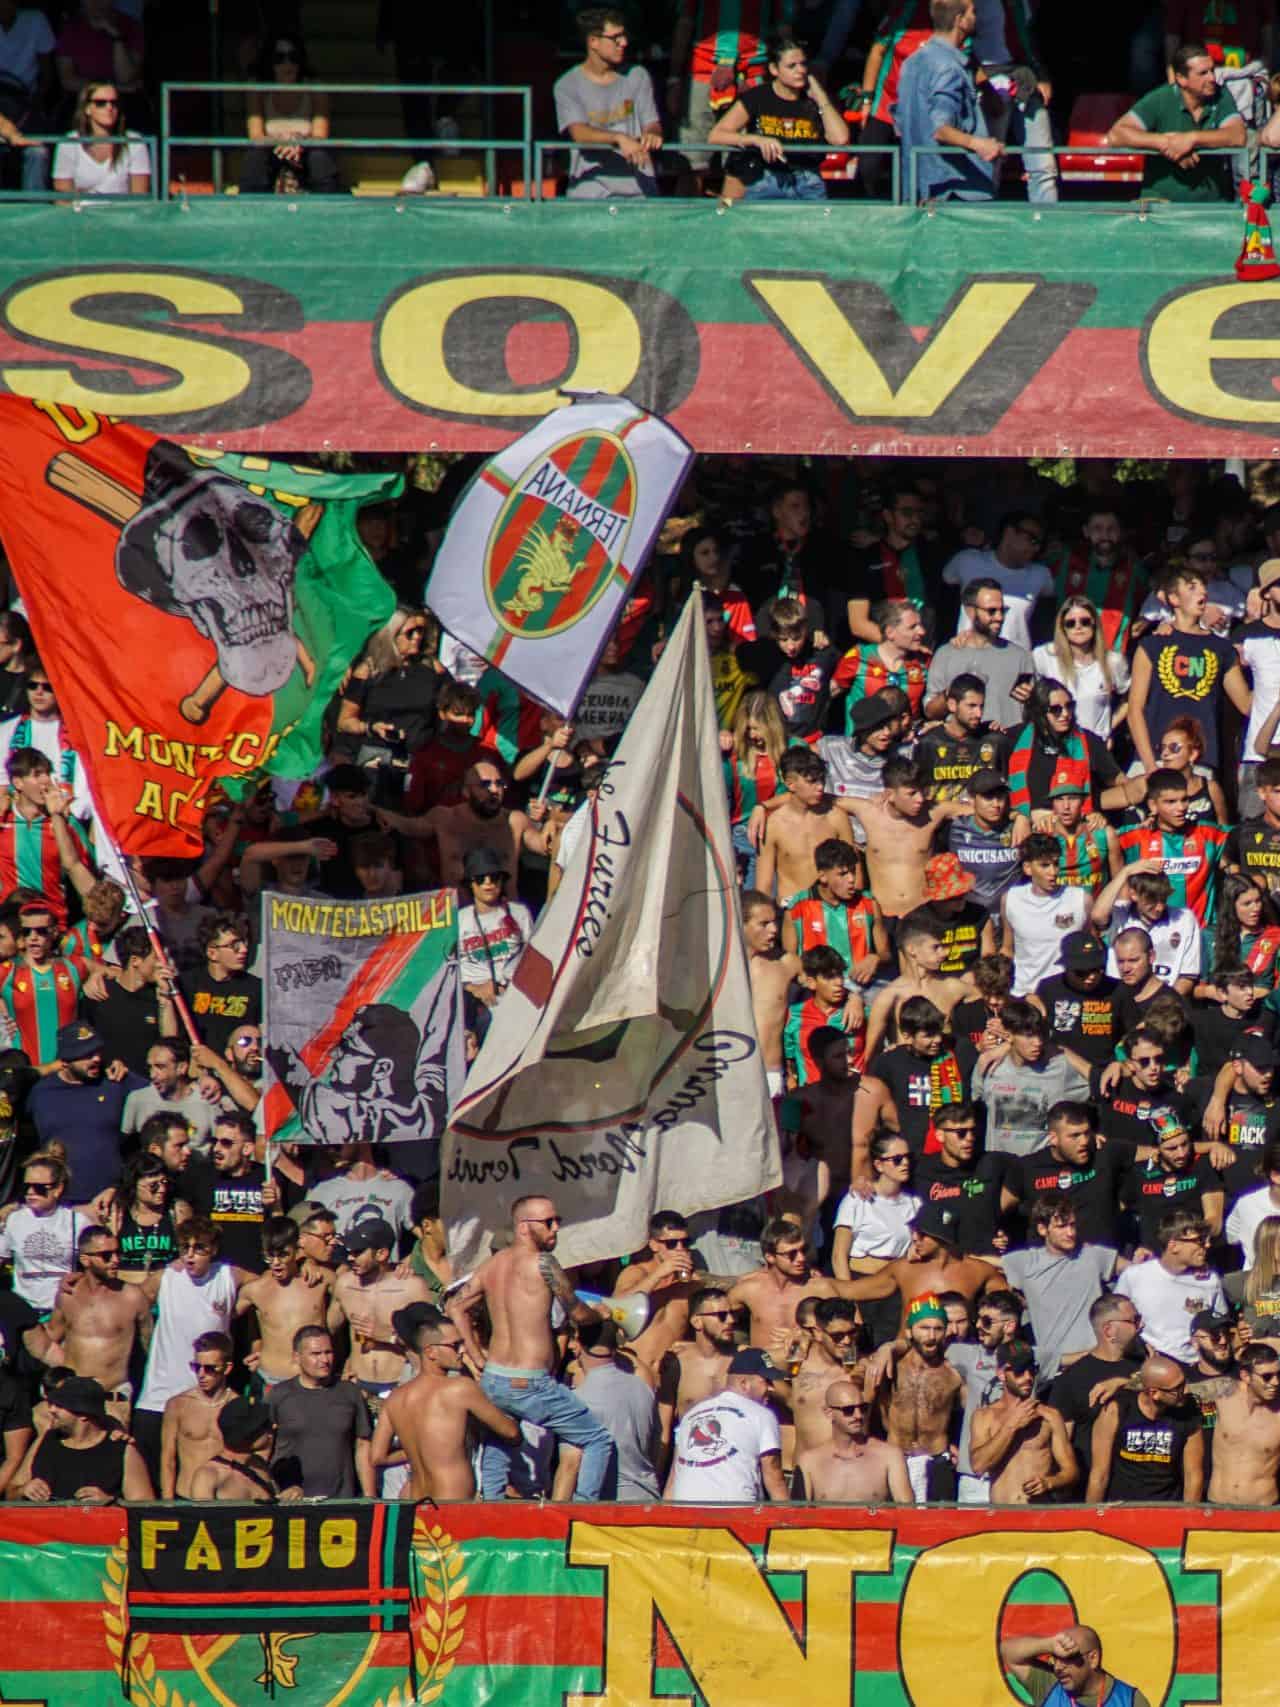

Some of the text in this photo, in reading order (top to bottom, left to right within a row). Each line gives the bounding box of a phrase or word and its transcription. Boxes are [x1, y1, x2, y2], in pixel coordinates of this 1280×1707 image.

[1173, 665, 1204, 688] CN
[271, 896, 453, 938] MONTECASTRILLI
[1229, 1123, 1265, 1145] BACK
[121, 1235, 171, 1251] NEON
[141, 1517, 358, 1571] FABIO
